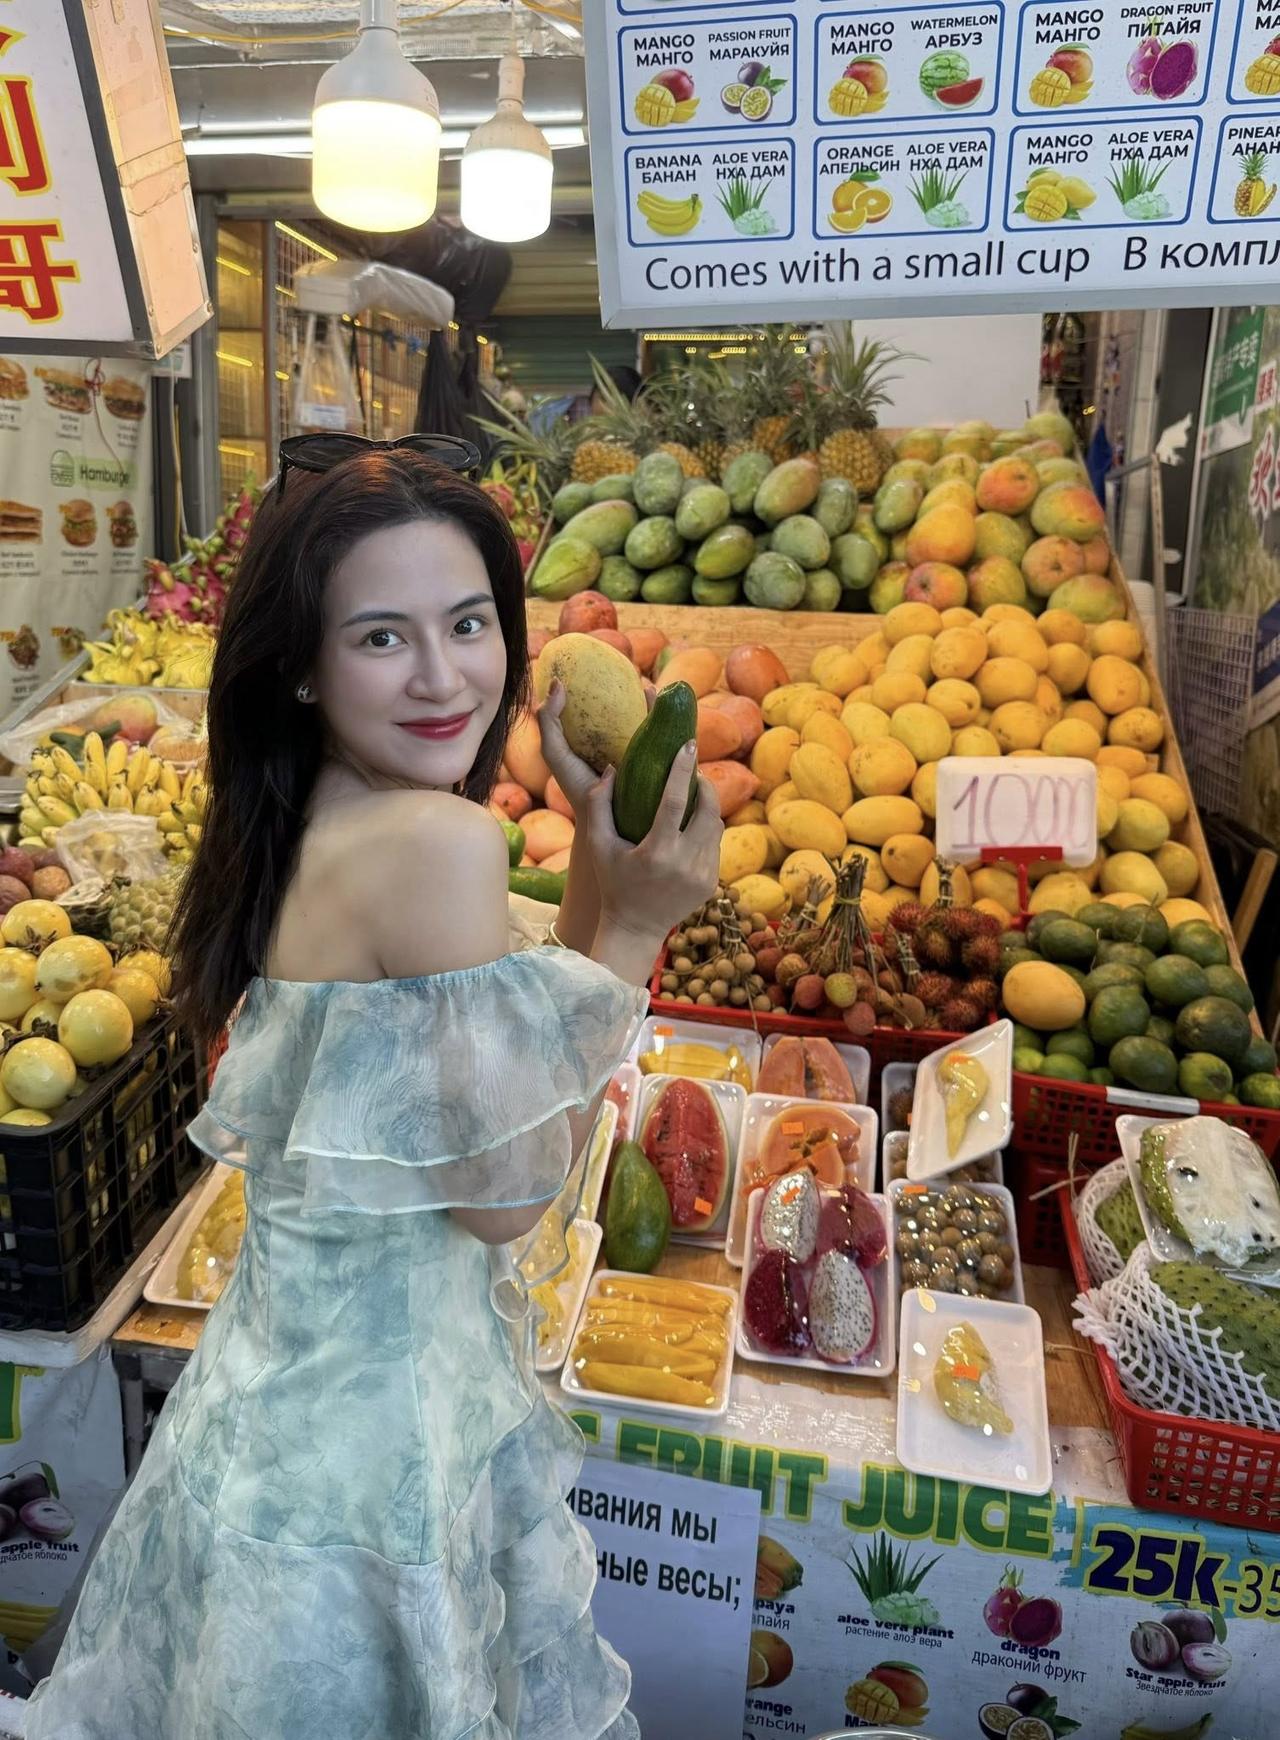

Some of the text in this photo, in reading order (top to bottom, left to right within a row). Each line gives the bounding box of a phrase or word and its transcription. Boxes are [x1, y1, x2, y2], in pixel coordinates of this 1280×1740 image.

[1035, 9, 1104, 27] MANGO
[1120, 1, 1214, 19] DRAGON FRUIT
[830, 21, 895, 39] MANGO
[910, 14, 998, 31] WATERMELON
[1127, 19, 1202, 38] ПИТАЙЯ
[633, 34, 695, 51] MANGO
[708, 28, 791, 43] PASSION FRUIT
[925, 32, 983, 49] АРБУЗ
[1035, 26, 1100, 44] МАНГО
[710, 44, 790, 61] МАРАКУЙЯ
[831, 39, 893, 55] МАНГО
[636, 51, 693, 67] МАНГО
[1026, 133, 1093, 150] MANGO
[1108, 129, 1195, 145] ALOE VERA
[826, 144, 894, 160] ORANGE
[906, 140, 988, 156] ALOE VERA
[1110, 144, 1189, 161] НХА ДАМ
[635, 154, 703, 169] BANANA
[712, 150, 789, 165] ALOE VERA
[910, 155, 984, 171] НХА ДАМ
[1028, 150, 1088, 165] МАНГО
[716, 165, 786, 181] НХА ДАМ
[819, 159, 900, 175] АПЕЛЬСИН
[641, 169, 696, 184] БАНАН
[1123, 236, 1149, 271] В
[646, 240, 1090, 291] Comes with a small cup
[843, 1464, 1056, 1558] JUICE
[671, 1508, 717, 1544] мы
[657, 1563, 741, 1611] весы;
[837, 1614, 870, 1627] aloe
[912, 1625, 955, 1640] plant
[845, 1624, 943, 1649] растение алоэ вера
[1000, 1639, 1061, 1661] dragon
[971, 1650, 1088, 1683] драконий фрукт
[1125, 1667, 1153, 1682] Star
[1157, 1676, 1194, 1689] apple
